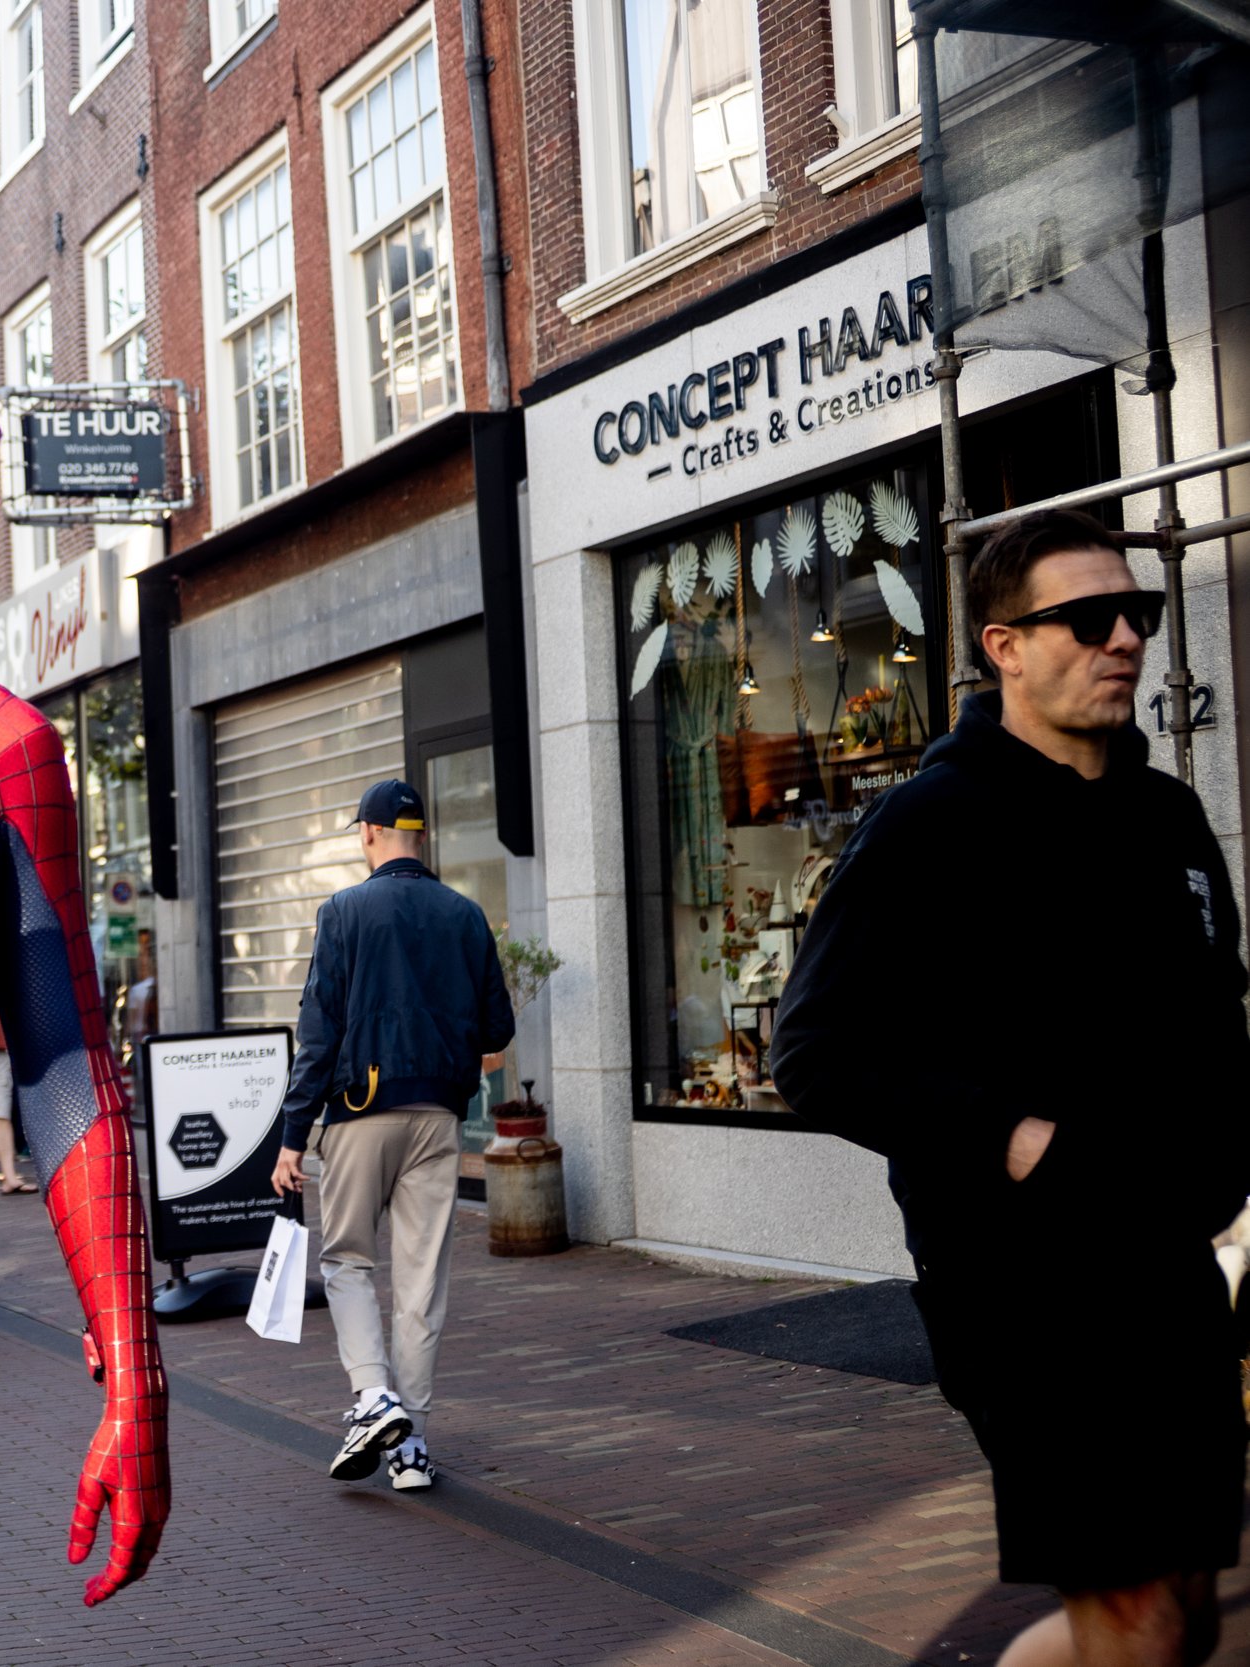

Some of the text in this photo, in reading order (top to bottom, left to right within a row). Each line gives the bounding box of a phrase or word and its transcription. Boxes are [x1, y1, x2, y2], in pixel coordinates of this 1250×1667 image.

[594, 337, 785, 465] CONCEPT
[34, 410, 161, 437] TE HUUR
[682, 361, 939, 477] Crafts & Creations
[58, 463, 82, 475] 020
[1149, 686, 1213, 733] 12
[852, 773, 892, 790] Meester
[894, 769, 905, 785] In
[163, 1047, 277, 1066] CONCEPT HAARLEM
[244, 1075, 275, 1088] shop
[251, 1087, 263, 1097] in
[228, 1098, 260, 1110] shop
[171, 1197, 285, 1214] The sustainable hive of creative
